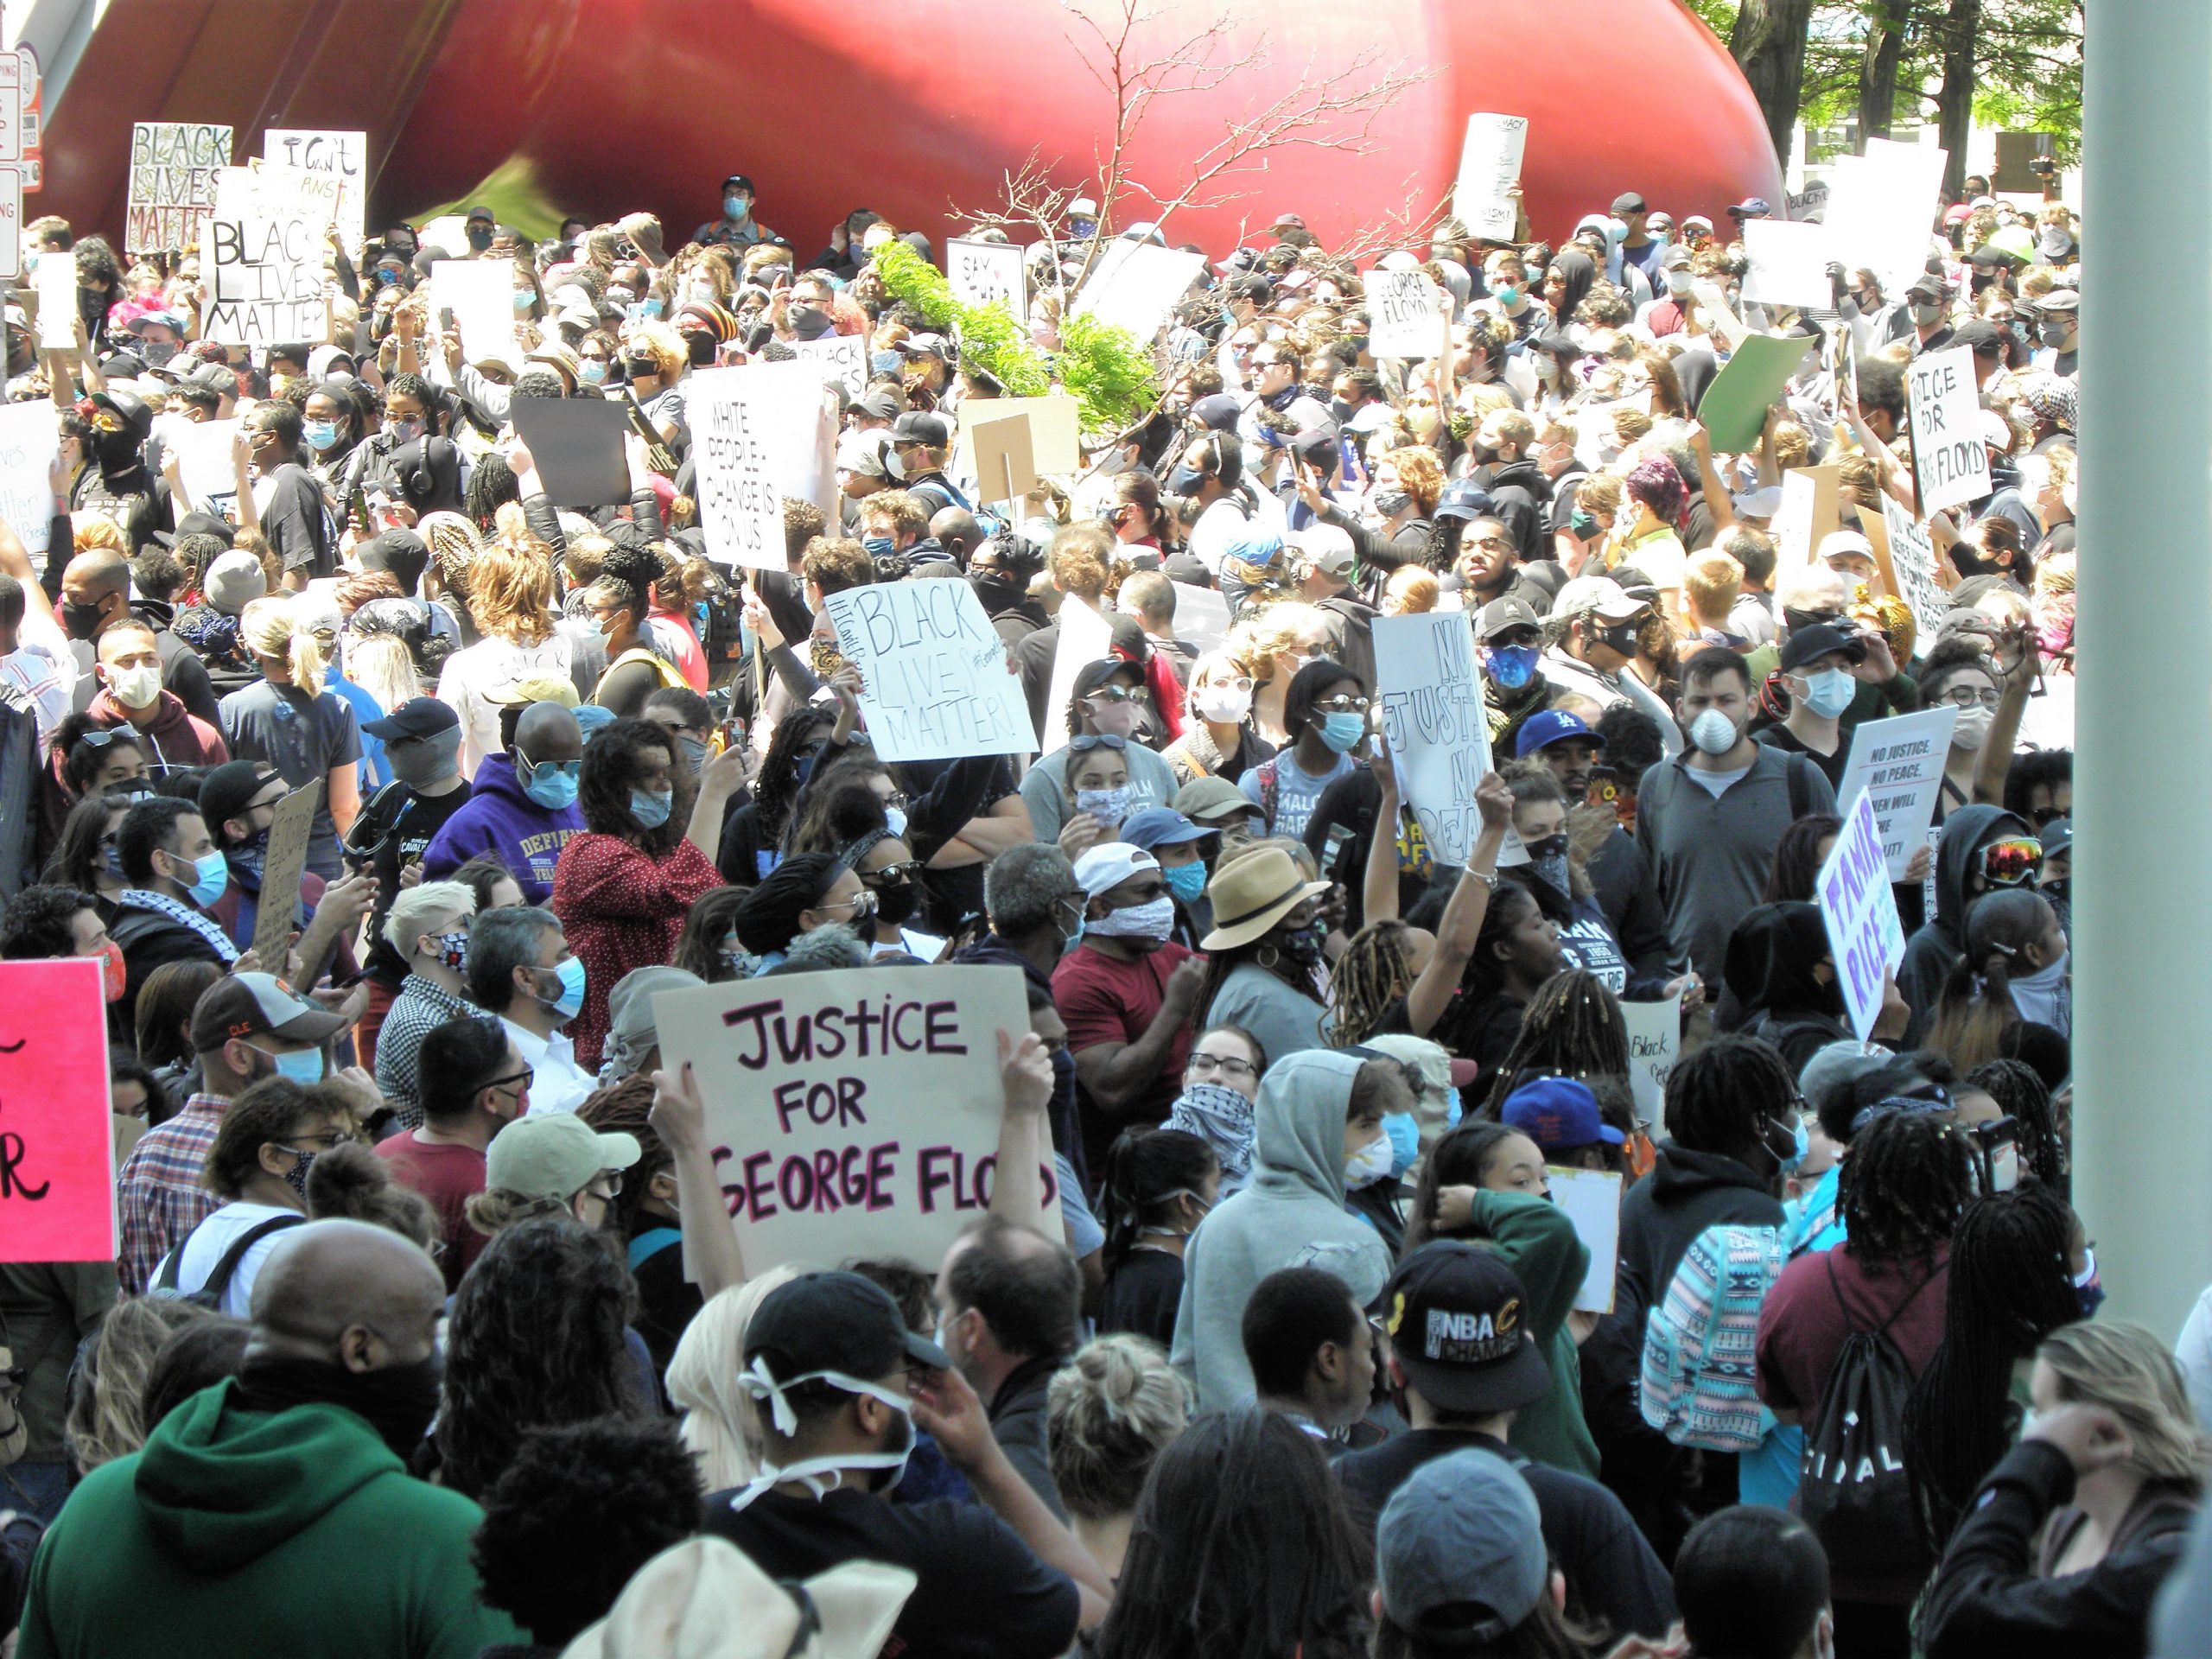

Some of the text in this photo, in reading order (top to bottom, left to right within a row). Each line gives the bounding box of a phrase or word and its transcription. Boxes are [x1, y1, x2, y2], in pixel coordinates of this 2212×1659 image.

[135, 125, 232, 168] BLACK
[129, 205, 216, 250] MATTE
[213, 219, 318, 266] BLAC
[215, 263, 323, 303] LIVES
[963, 255, 990, 282] SAY
[1382, 299, 1428, 325] FLOYD
[712, 400, 750, 435] WHITE
[1936, 440, 1986, 488] FLOYD
[705, 475, 776, 516] CHANGE IS
[721, 514, 762, 550] ON US
[854, 584, 982, 658] BLACK
[874, 645, 977, 709] LIVES
[885, 692, 1017, 754] MATTER!
[1382, 682, 1484, 753] JUST
[1554, 711, 1579, 728] LA
[1870, 747, 1886, 763] NO
[1870, 770, 1885, 785] NO
[1872, 792, 1917, 814] HEN WILL
[1846, 903, 1889, 1009] RICE
[228, 1020, 251, 1037] CLE
[772, 1076, 868, 1135] FOR
[709, 1141, 901, 1224] GEORGE
[1440, 1312, 1496, 1341] NBA
